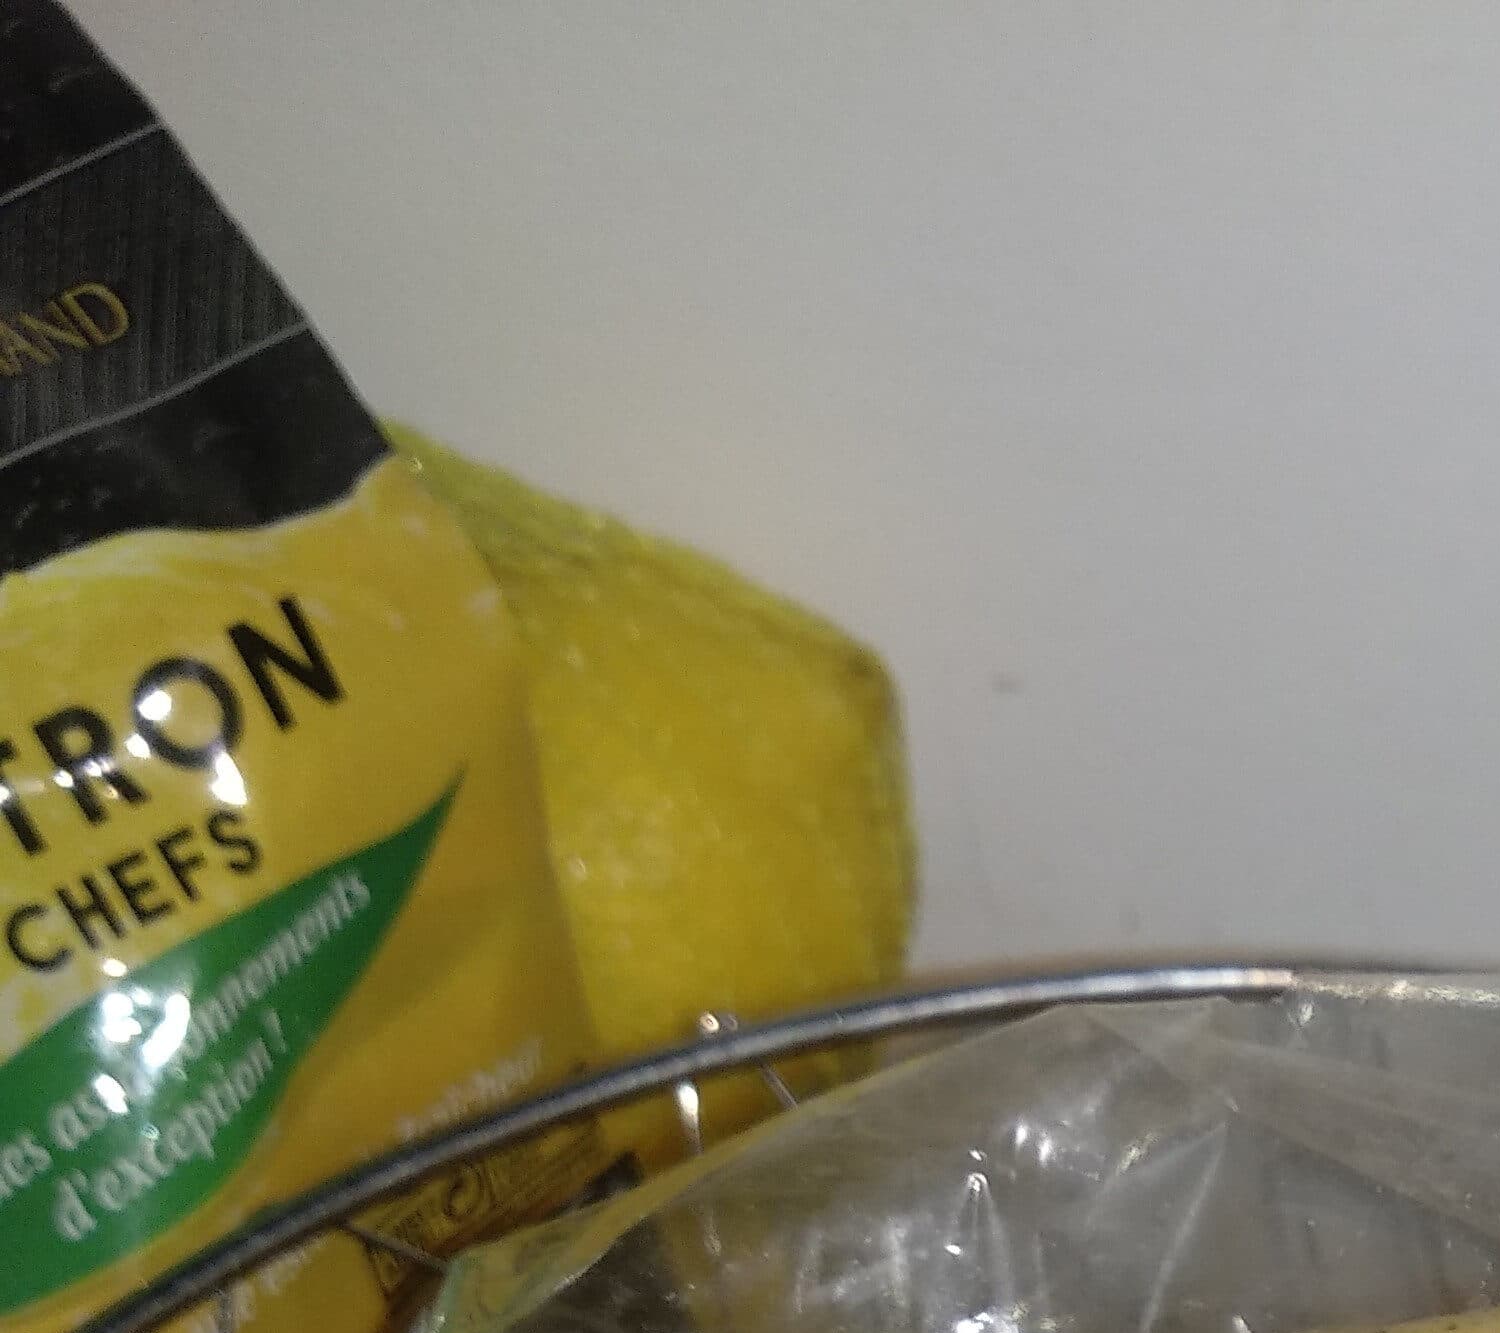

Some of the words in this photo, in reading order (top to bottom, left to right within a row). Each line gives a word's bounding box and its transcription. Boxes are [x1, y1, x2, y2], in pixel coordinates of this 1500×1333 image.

[0, 594, 346, 856] TRON
[5, 808, 263, 971] CHEFS
[0, 1129, 52, 1199] es
[50, 867, 371, 1149] asonnements
